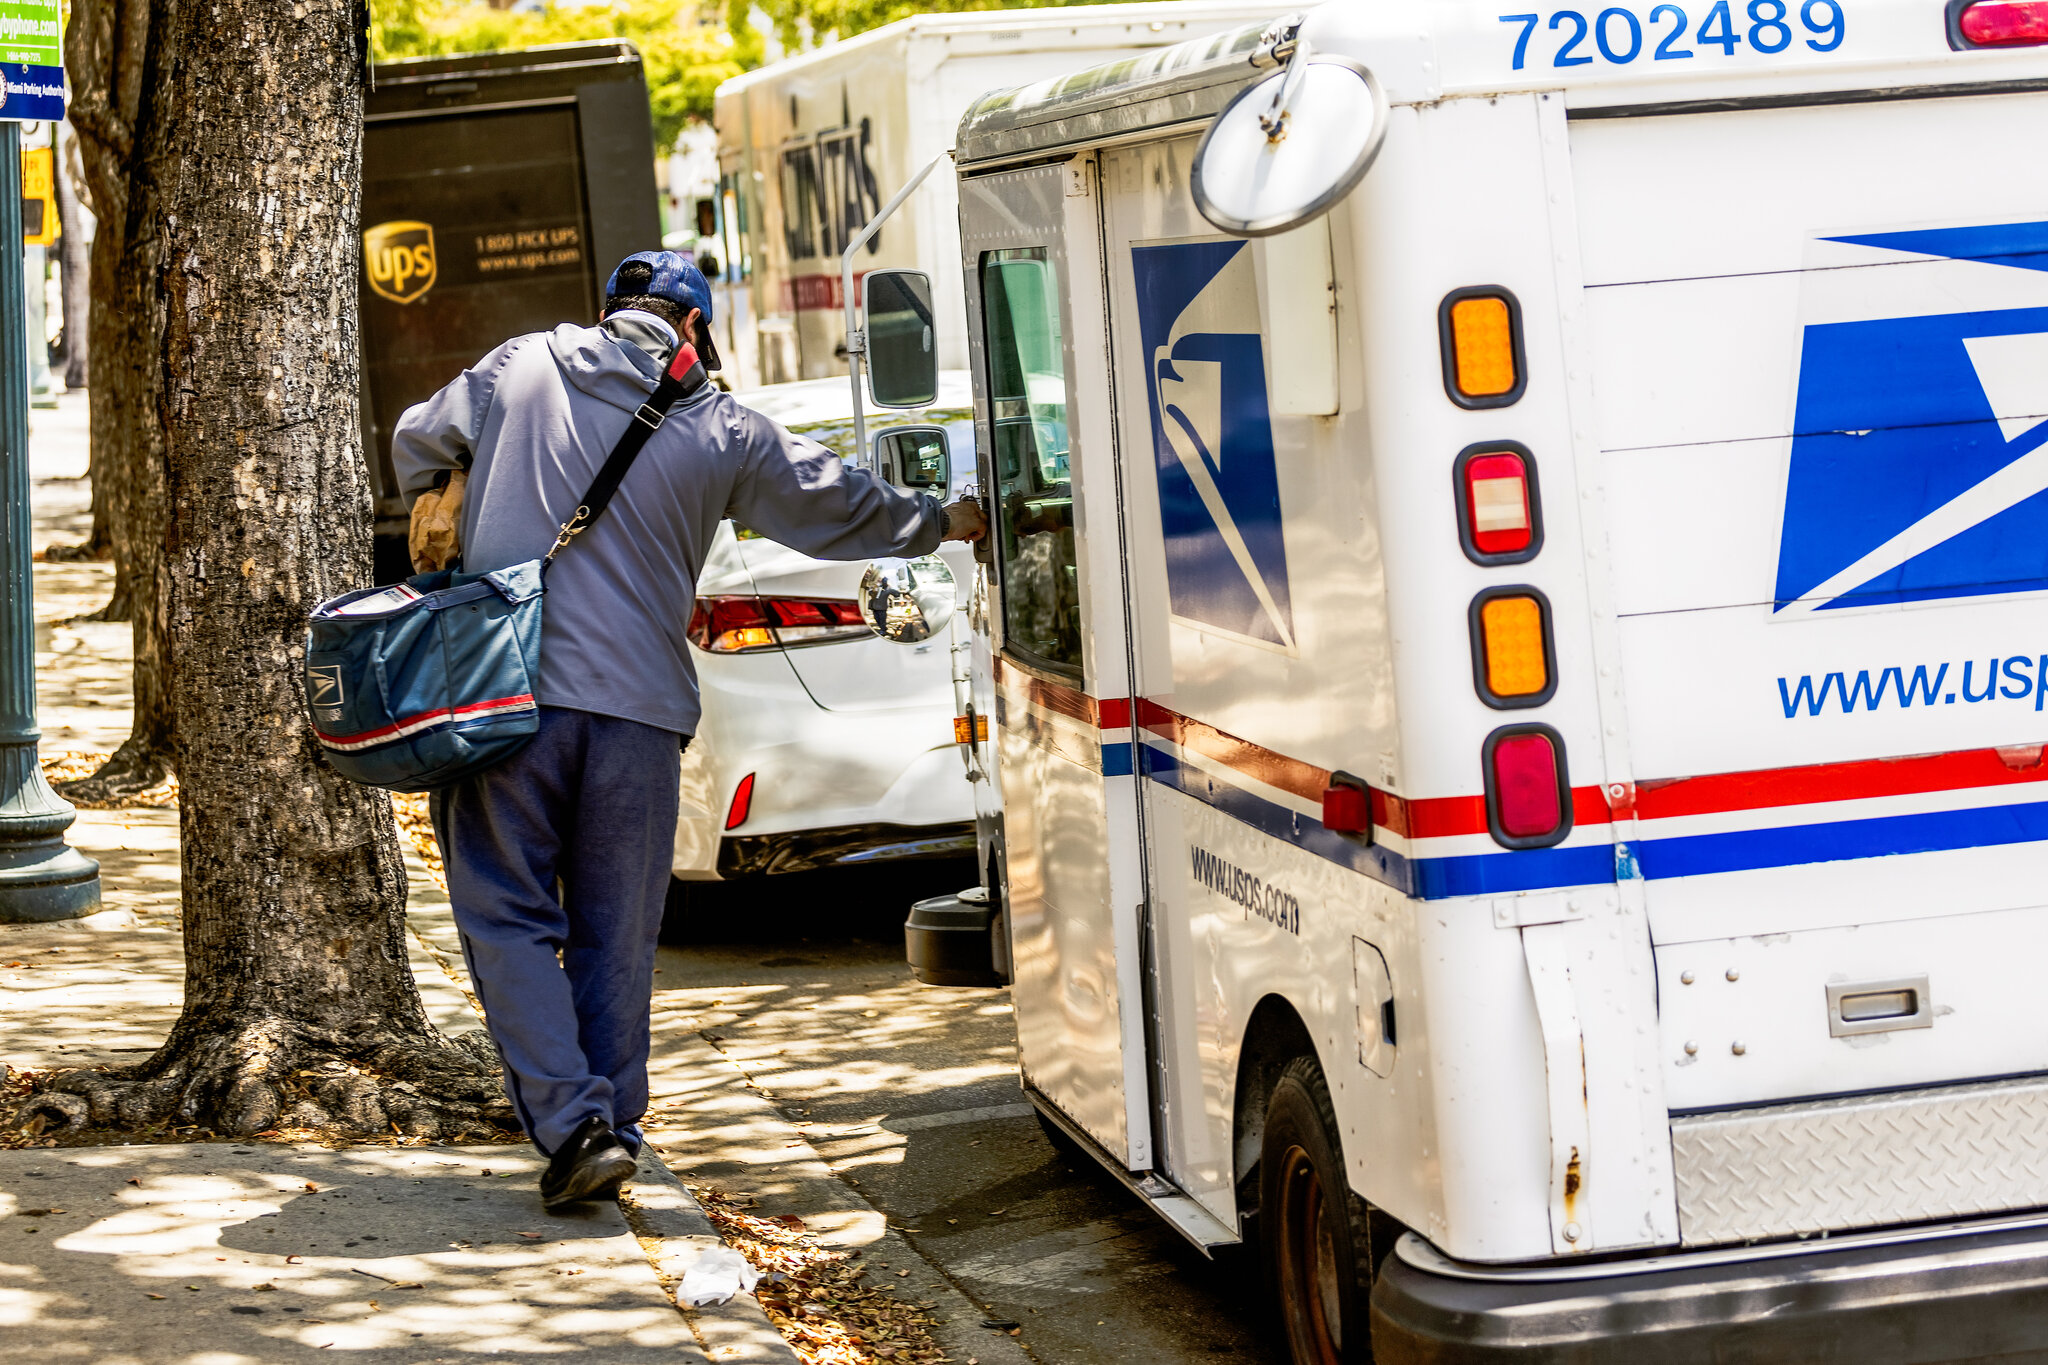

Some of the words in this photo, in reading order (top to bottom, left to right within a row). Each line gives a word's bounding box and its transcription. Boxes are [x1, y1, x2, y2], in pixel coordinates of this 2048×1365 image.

[1499, 0, 1846, 70] 7202489
[7, 82, 23, 94] Miami
[23, 82, 42, 98] Parking
[475, 236, 485, 252] 1
[485, 233, 514, 251] 800
[516, 230, 549, 249] PICK
[551, 226, 580, 245] UPS
[477, 248, 581, 273] www.ups.com
[1191, 844, 1300, 936] www.usps.com
